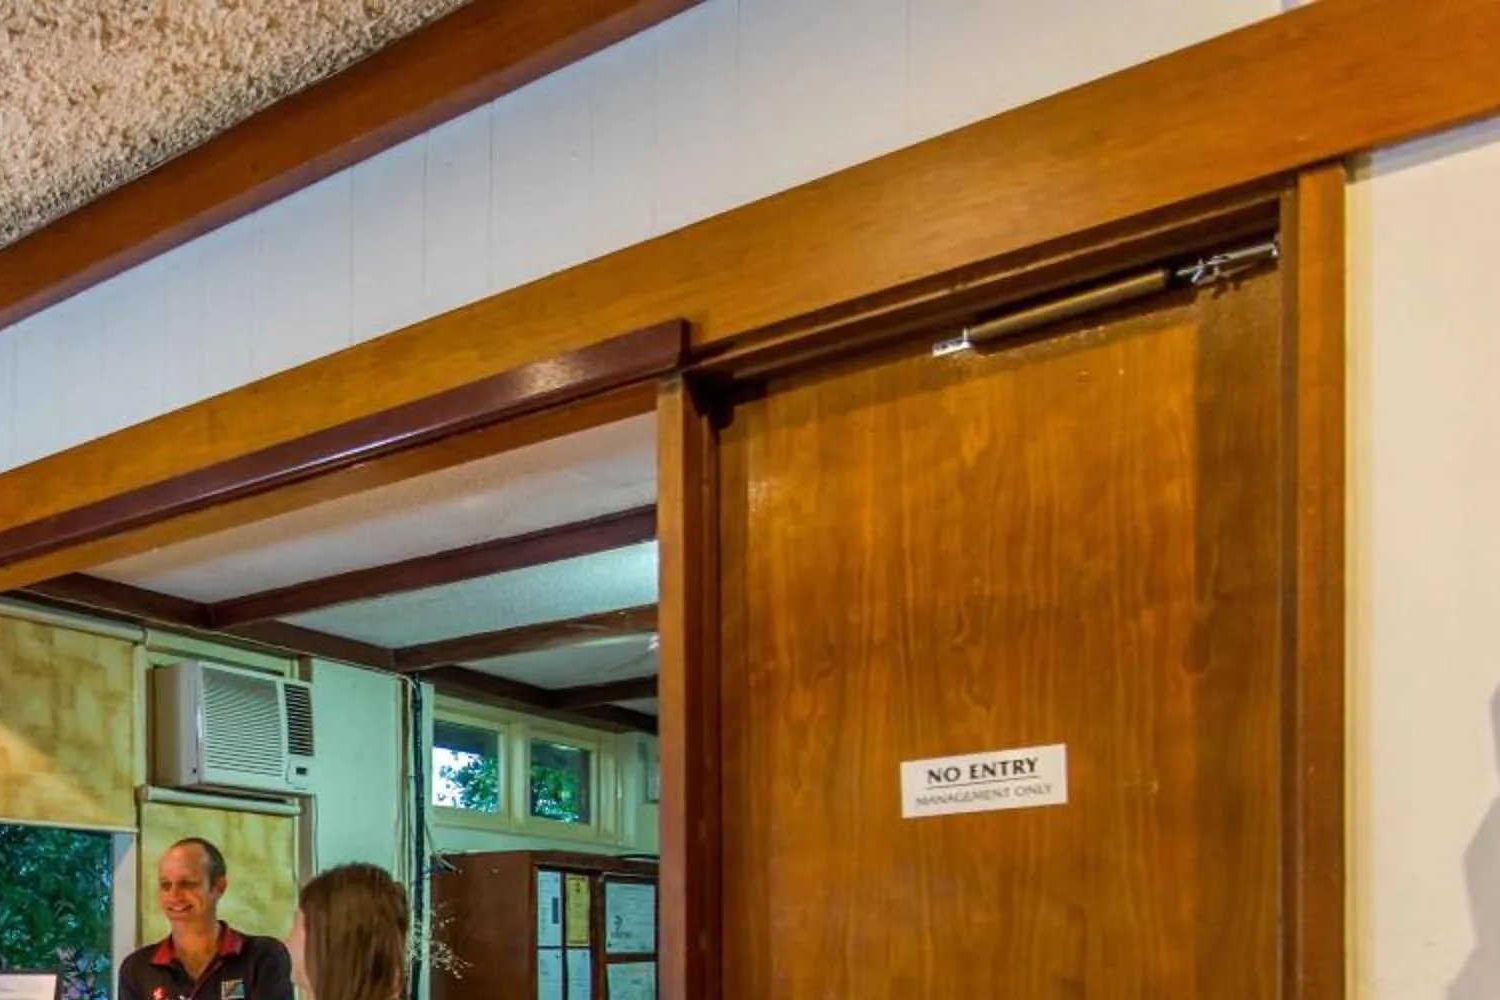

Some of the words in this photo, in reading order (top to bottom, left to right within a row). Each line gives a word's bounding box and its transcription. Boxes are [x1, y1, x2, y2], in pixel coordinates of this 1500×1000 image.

[927, 765, 961, 785] NO
[969, 756, 1039, 780] ENTRY
[915, 786, 1011, 806] MANAGEMENT
[1013, 782, 1054, 798] ONLY
